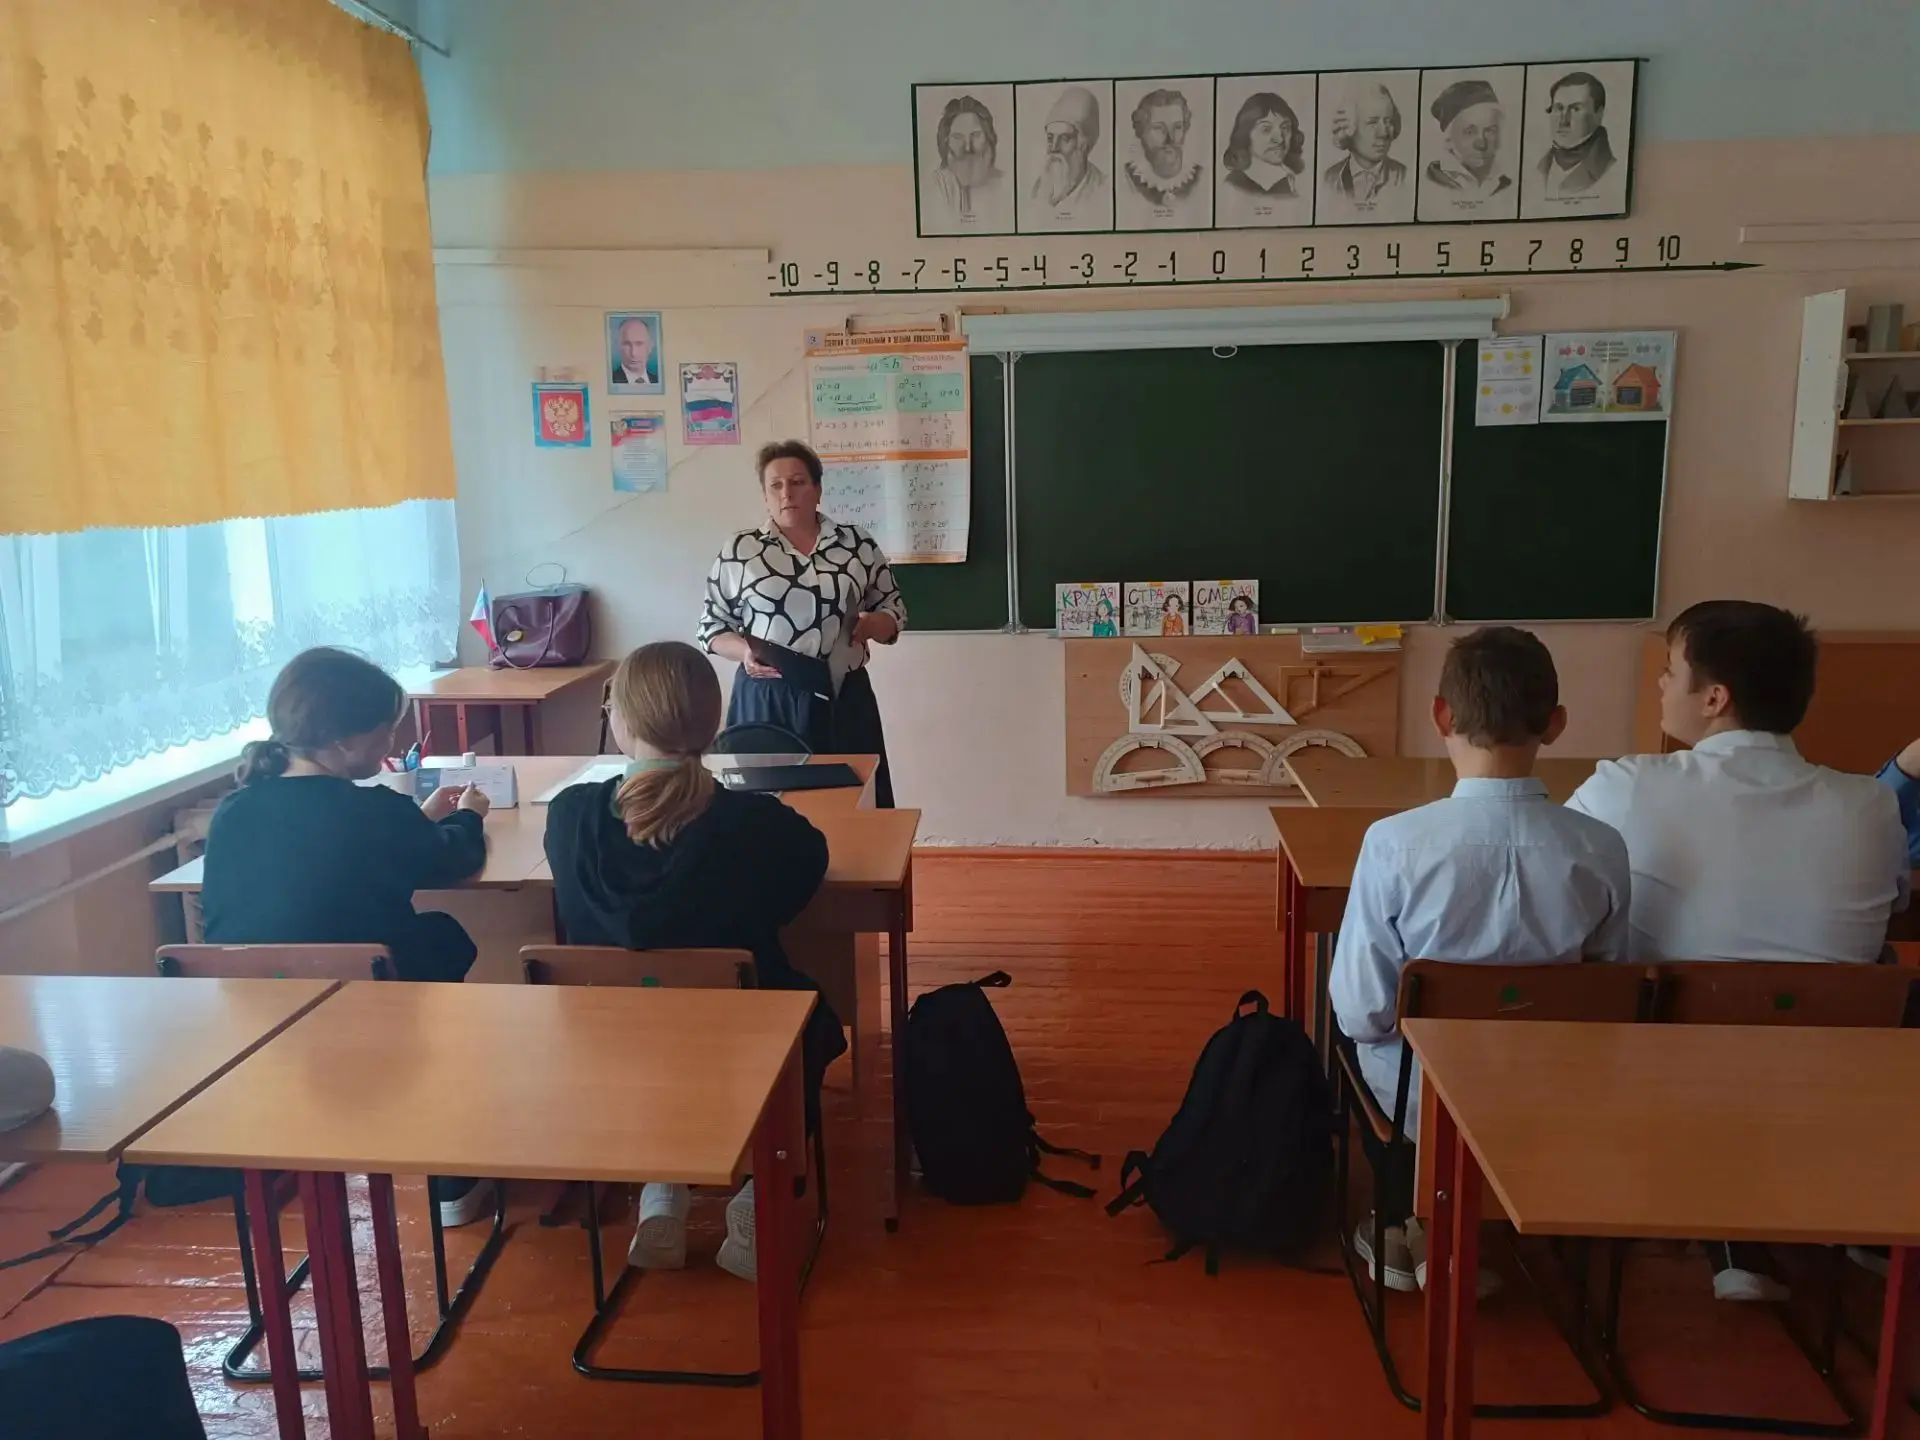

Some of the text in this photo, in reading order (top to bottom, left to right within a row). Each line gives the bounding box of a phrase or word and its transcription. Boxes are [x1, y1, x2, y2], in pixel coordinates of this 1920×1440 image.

[767, 234, 1681, 288] -10 -9 -8 -7 -6 -5 -4 -3 -2 -1 0 1 2 3 4 5 6 7 8 9 10
